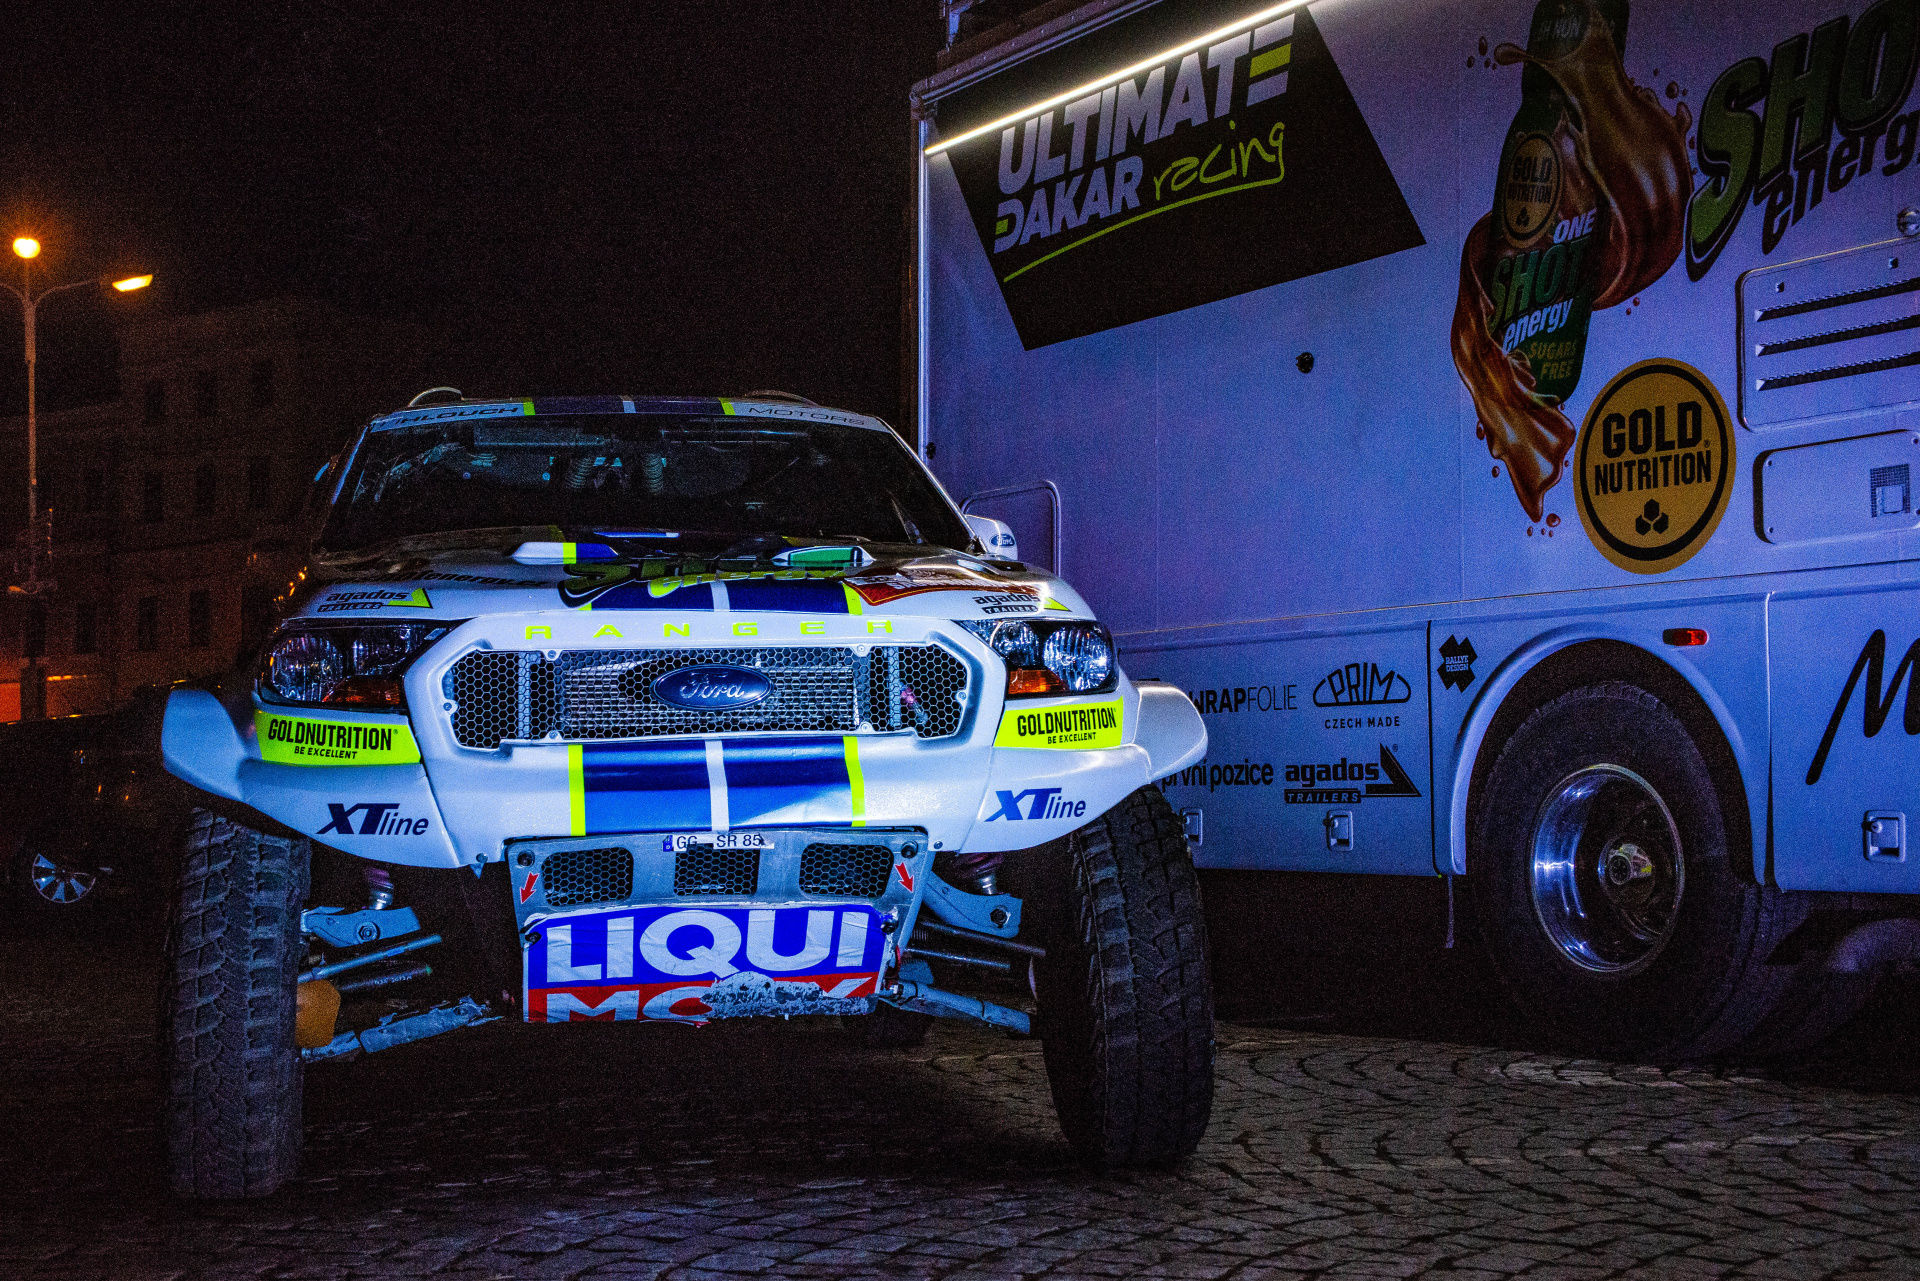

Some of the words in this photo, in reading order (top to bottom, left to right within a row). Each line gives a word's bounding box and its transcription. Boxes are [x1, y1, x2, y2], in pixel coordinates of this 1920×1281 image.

[998, 13, 1295, 195] ULTIMATE
[1513, 156, 1552, 182] GOLD
[1762, 111, 1920, 255] energ
[994, 154, 1143, 254] DAKAR
[1153, 120, 1286, 200] racing
[1553, 207, 1598, 244] ONE
[1490, 236, 1591, 336] SHOT
[1502, 298, 1574, 357] energy
[1541, 357, 1575, 380] FREE
[748, 407, 865, 426] MOTORS
[1602, 400, 1702, 458] GOLD
[1594, 450, 1712, 496] NUTRITION
[326, 590, 410, 603] agados
[972, 592, 1041, 606] agados
[525, 620, 893, 640] RANGER
[680, 671, 746, 699] Ford
[1327, 662, 1396, 703] PRIM
[268, 718, 392, 751] GOLDNUTRITION
[1016, 707, 1117, 737] GOLDNUTRITION
[1324, 716, 1362, 730] CZECH
[1367, 715, 1400, 728] MADE
[294, 745, 307, 755] BE
[308, 747, 357, 760] EXCELLENT
[1047, 735, 1057, 745] BE
[1059, 732, 1097, 744] EXCELLENT
[1210, 758, 1274, 793] pozice
[1285, 757, 1379, 787] agados
[983, 787, 1087, 822] XTline
[1286, 792, 1359, 803] TRAILERS
[315, 803, 429, 836] XTline
[716, 834, 738, 848] SR
[546, 909, 875, 982] LIQUI
